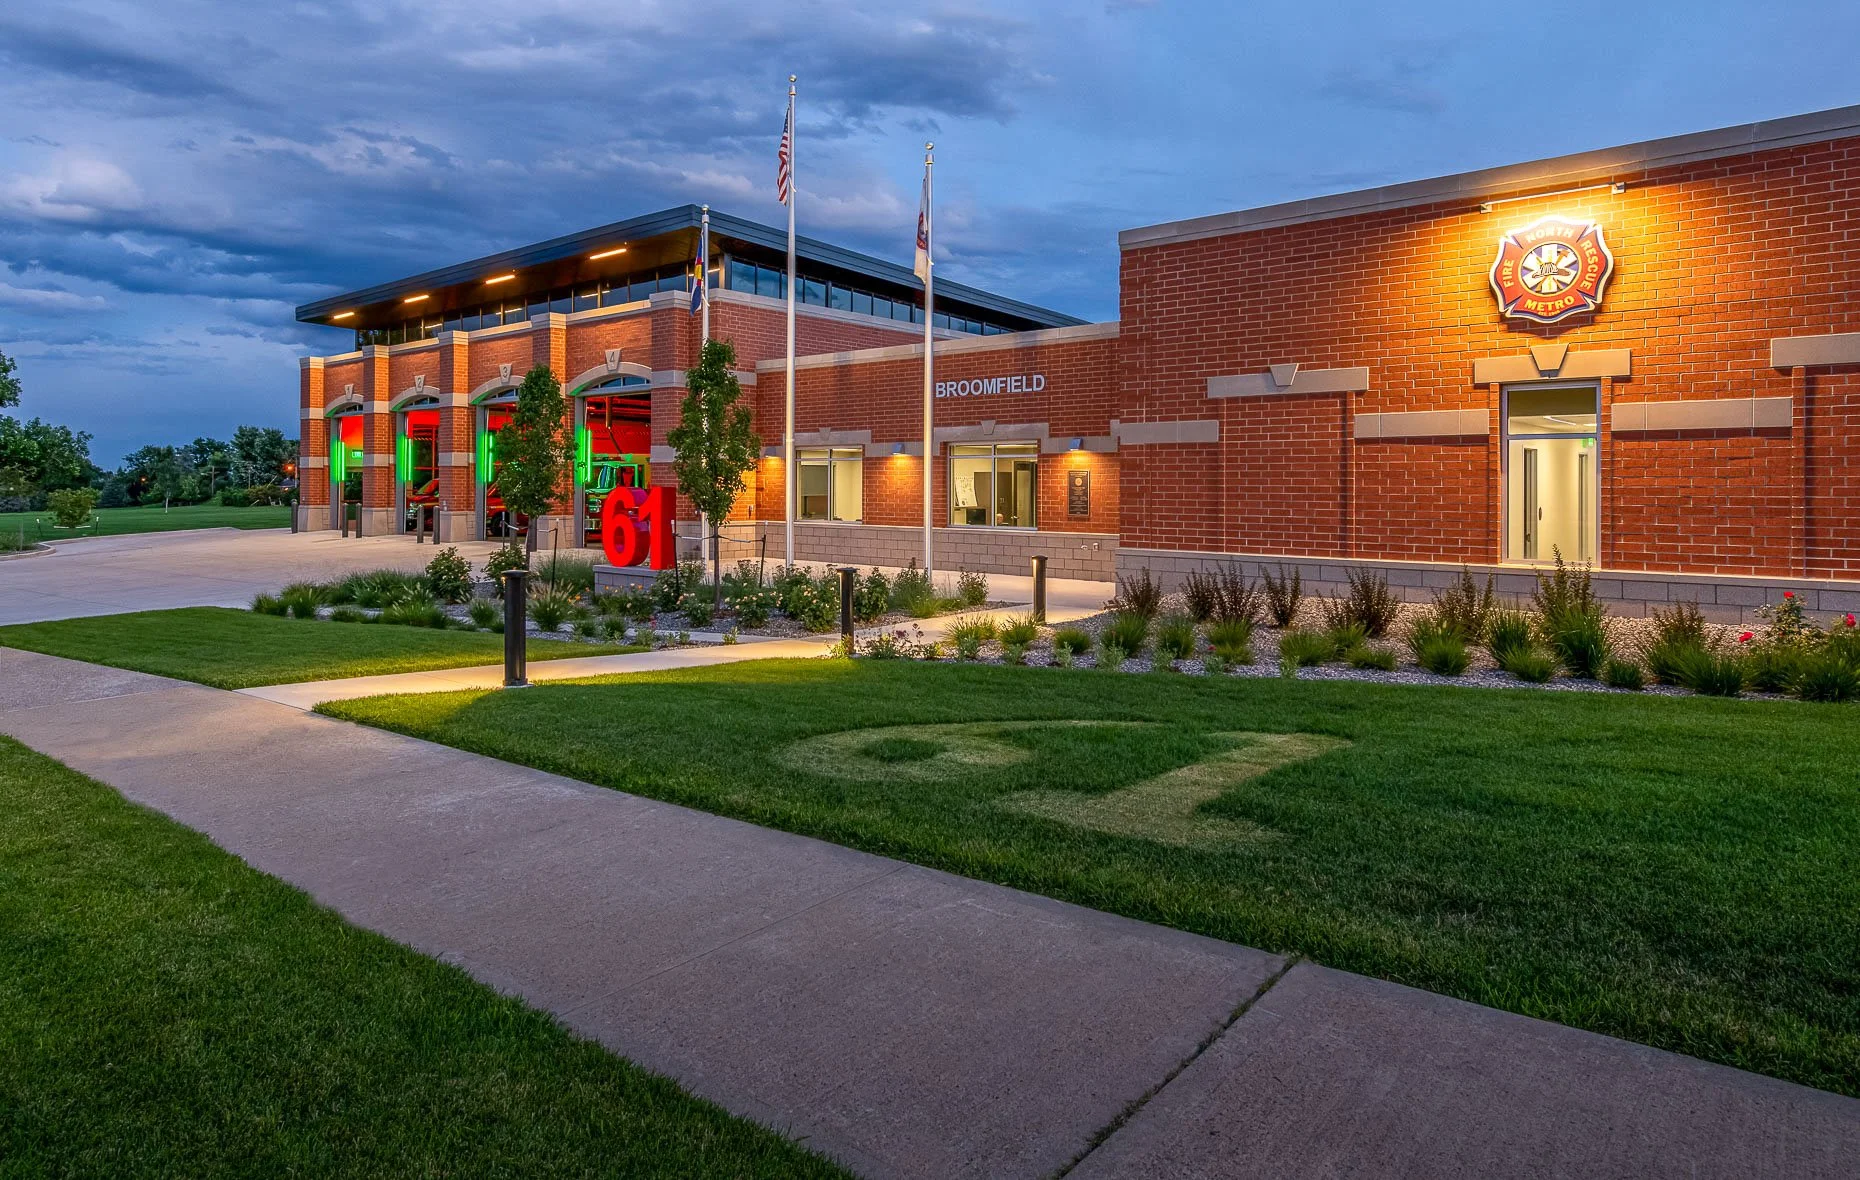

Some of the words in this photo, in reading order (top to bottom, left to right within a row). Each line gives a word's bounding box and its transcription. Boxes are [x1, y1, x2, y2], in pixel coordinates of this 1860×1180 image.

[1525, 225, 1574, 243] NORTH
[1502, 258, 1515, 288] FIRE
[1580, 239, 1599, 290] RESCUE
[1524, 295, 1575, 311] METRO
[609, 351, 615, 365] 4
[935, 374, 1046, 398] BROOMFIELD
[602, 485, 676, 570] 61
